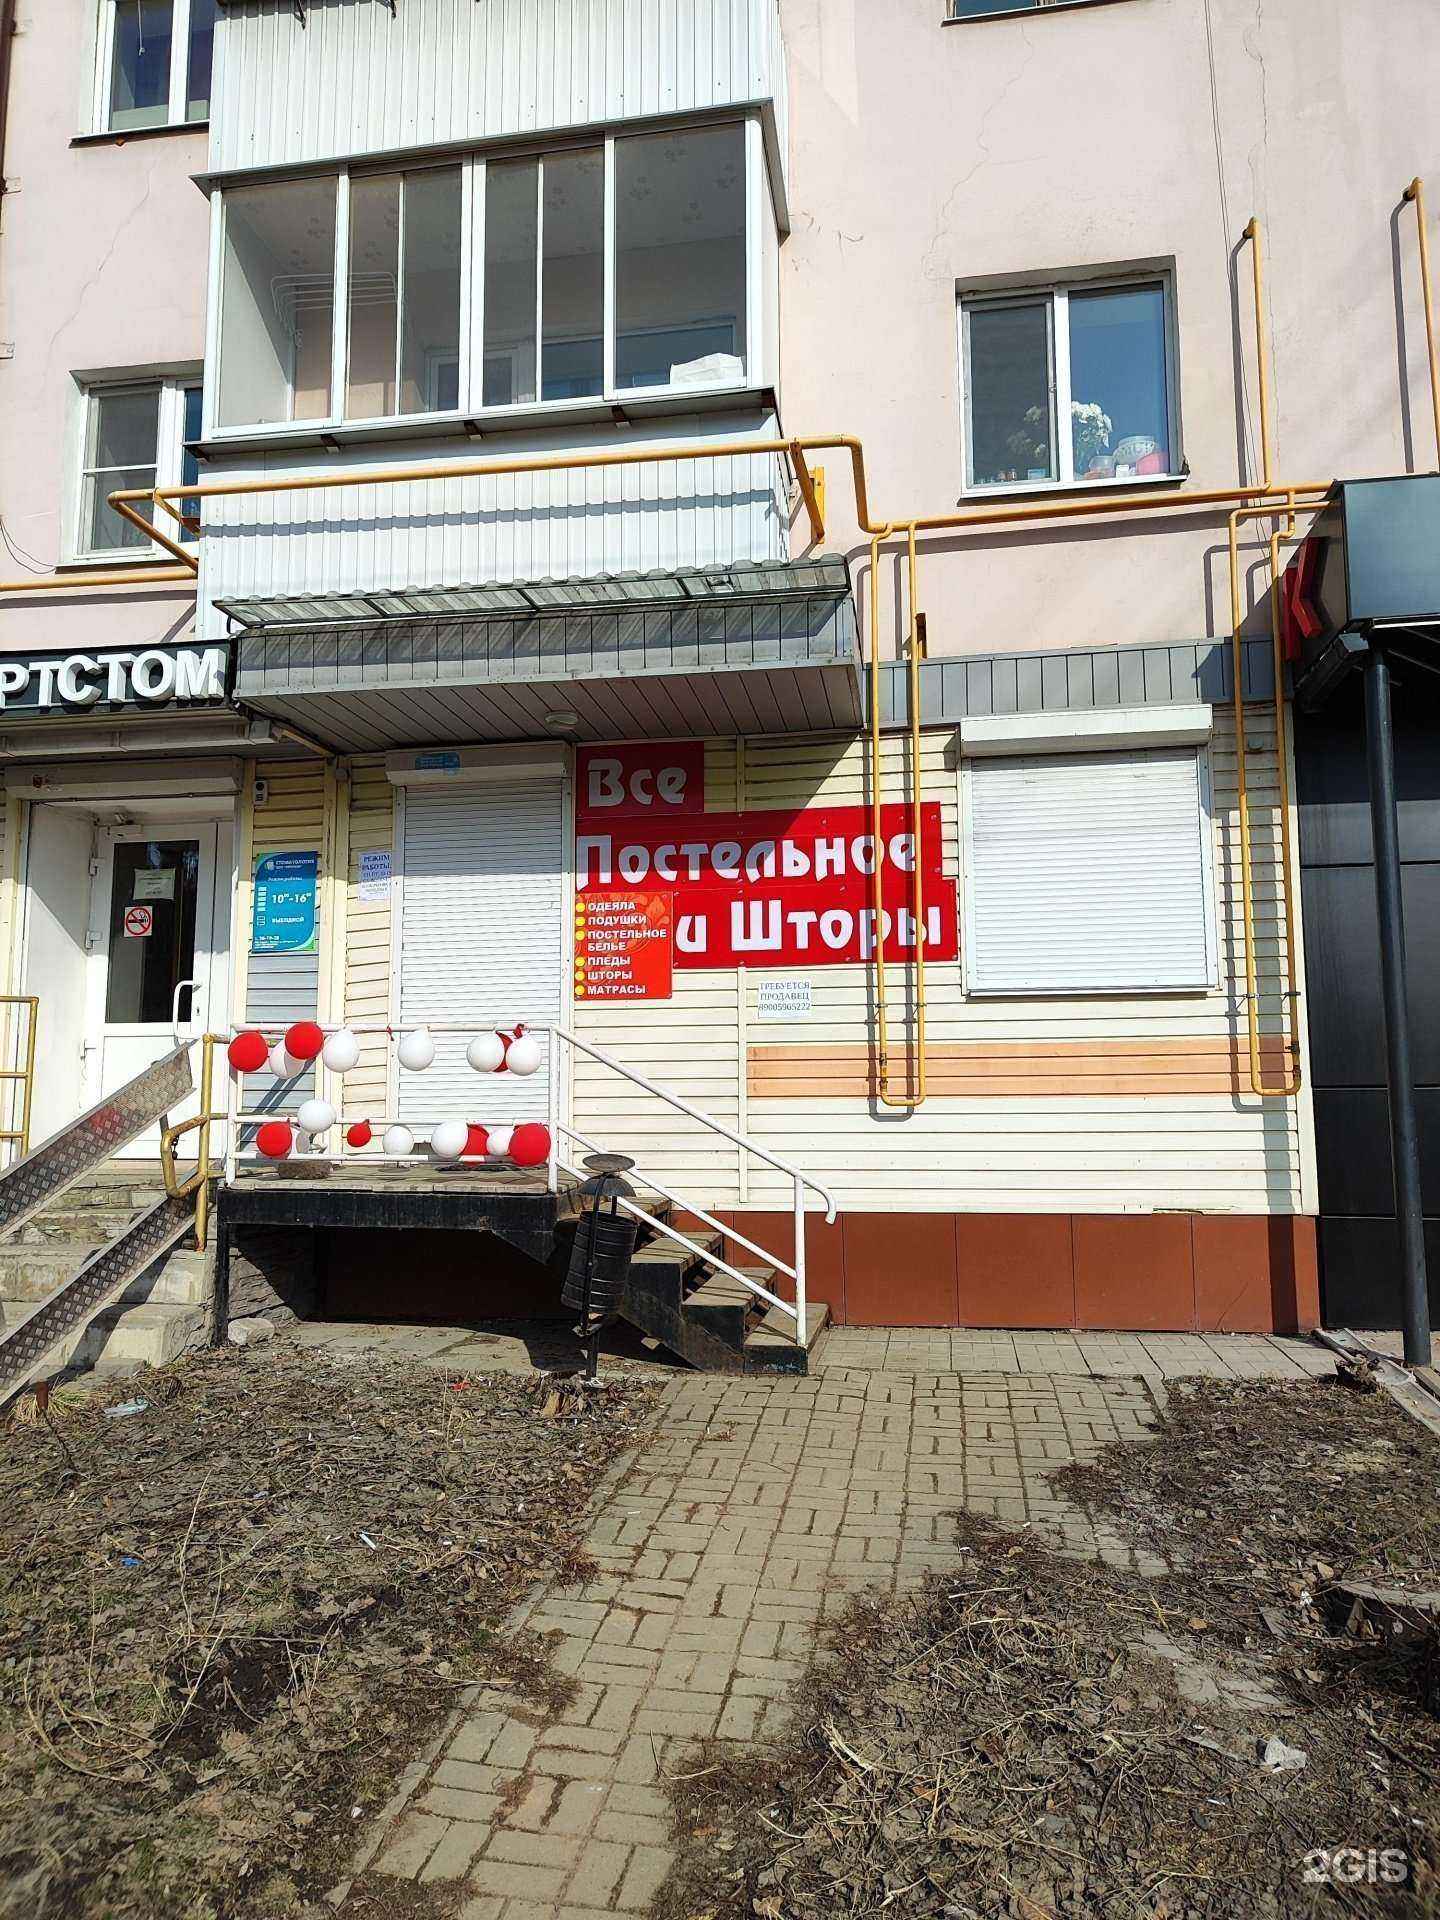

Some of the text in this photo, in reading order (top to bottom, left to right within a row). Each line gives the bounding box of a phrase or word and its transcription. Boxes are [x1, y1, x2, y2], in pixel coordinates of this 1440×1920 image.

[588, 758, 688, 808] Все
[576, 833, 919, 891] Постельное
[587, 901, 636, 912] ОДЕЯЛА
[588, 915, 647, 927] ПОДУШКИ
[587, 928, 667, 940] ПОСТЕЛЬНОЕ
[676, 899, 942, 960] и Шторы
[587, 941, 627, 952] БЕЛЬЕ
[587, 956, 631, 967] ПЛЕДЫ
[587, 970, 633, 981] ШТОРЫ
[587, 984, 646, 995] МАТРАСЫ
[760, 981, 810, 990] ТРЕБУЕТСЯ
[760, 992, 810, 1001] ПРОДАВЕЦ
